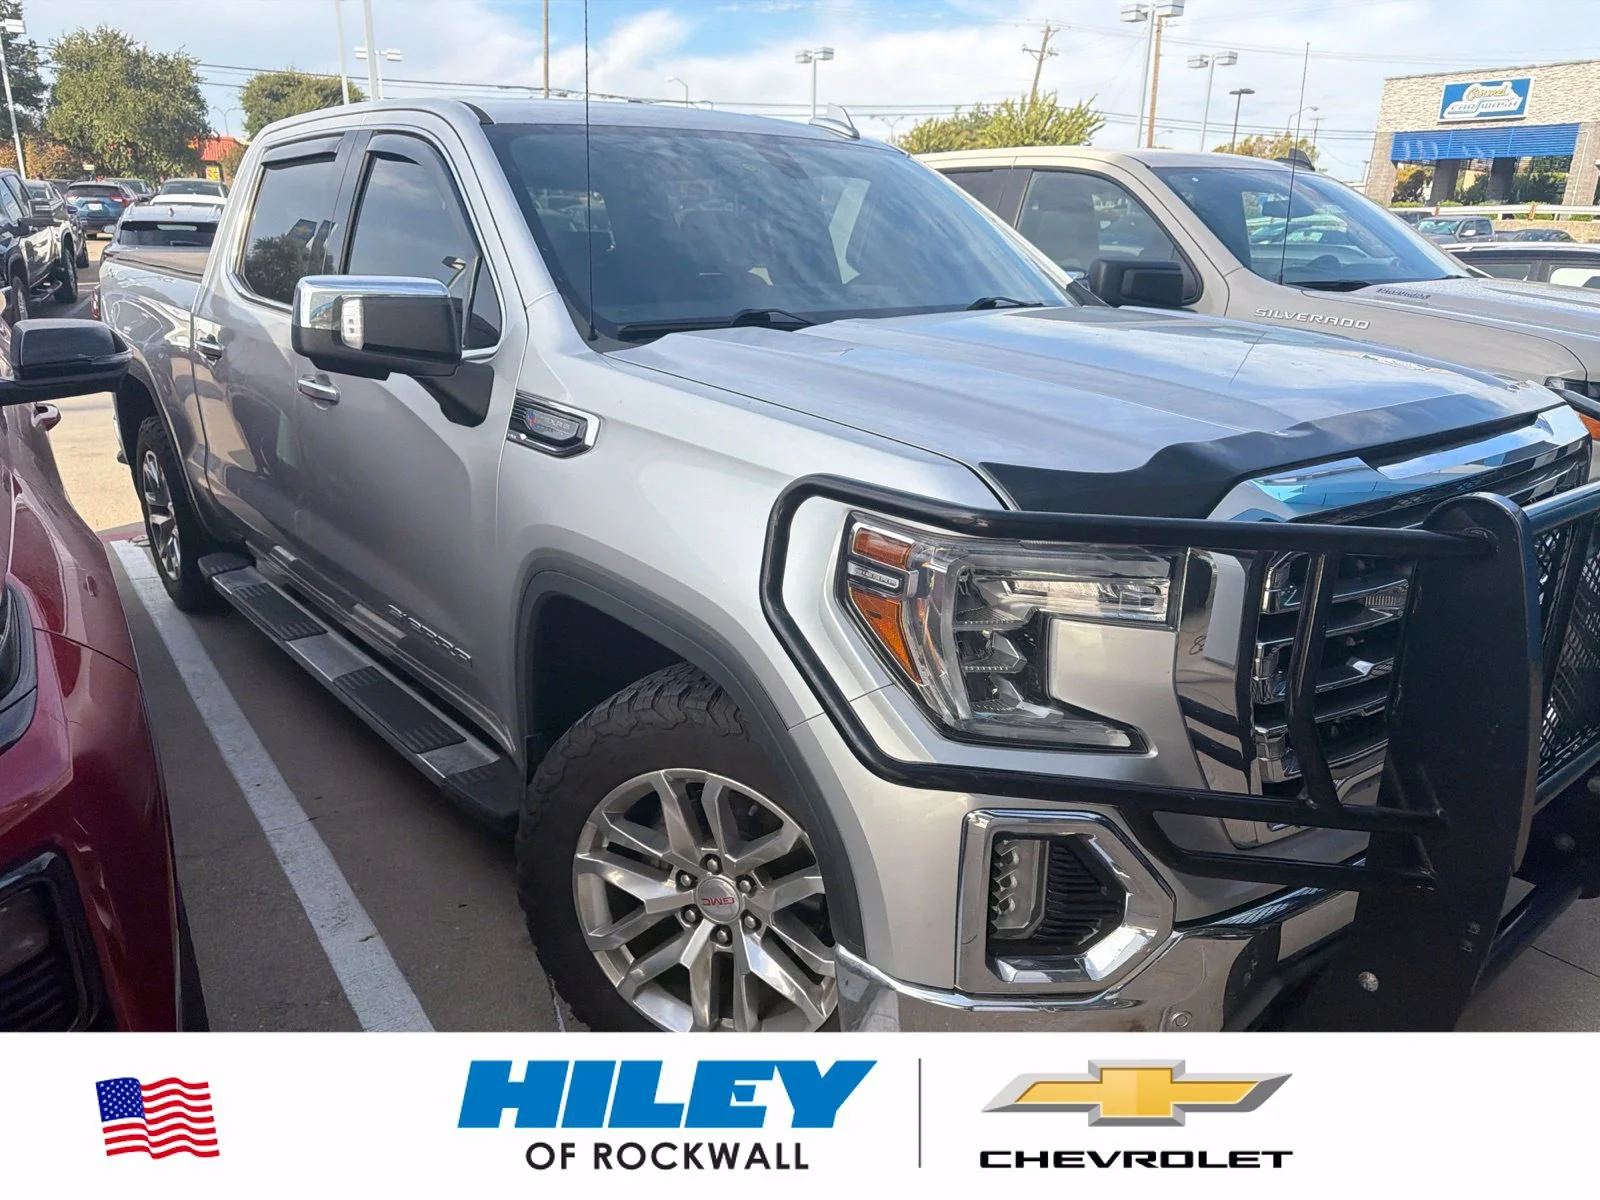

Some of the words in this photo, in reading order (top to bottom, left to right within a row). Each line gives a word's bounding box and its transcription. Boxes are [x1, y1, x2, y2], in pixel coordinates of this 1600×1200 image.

[1481, 100, 1518, 109] WASH
[1254, 308, 1372, 330] SILVERADO
[702, 896, 735, 906] GMC
